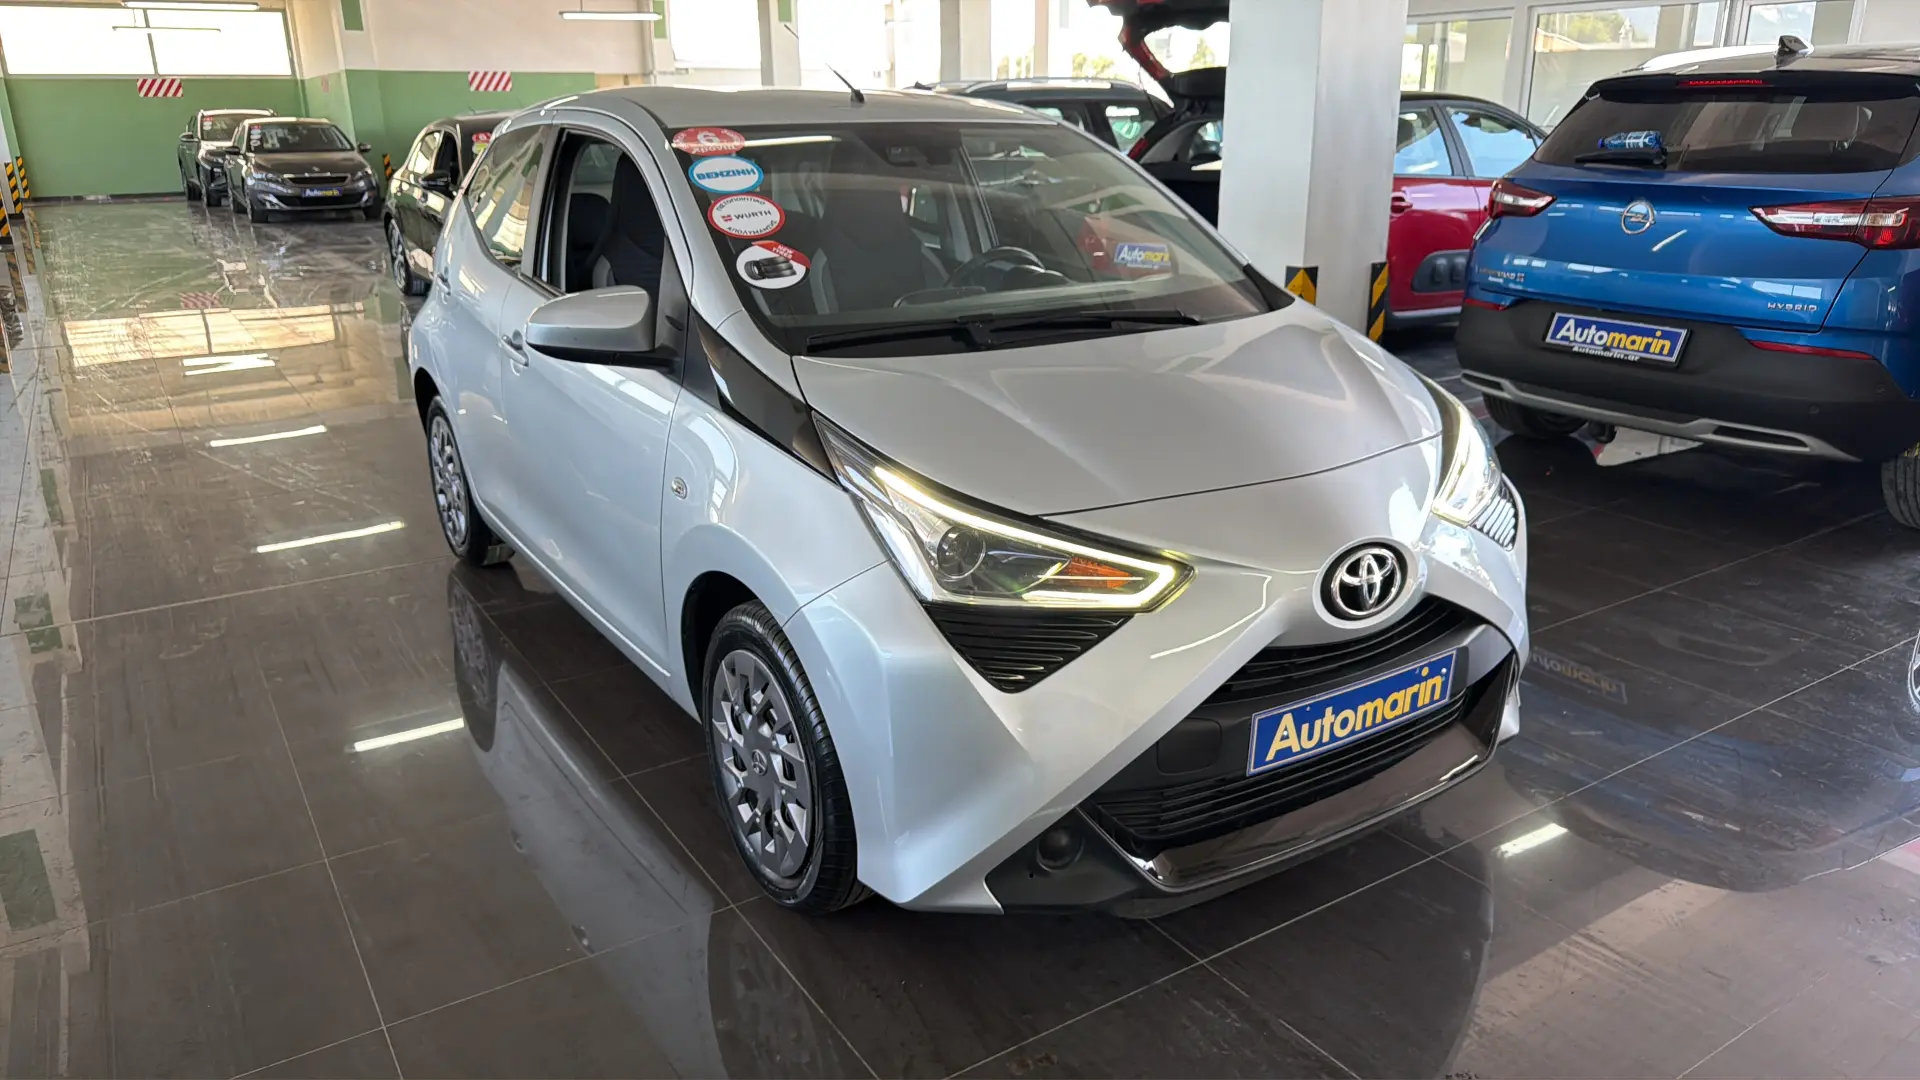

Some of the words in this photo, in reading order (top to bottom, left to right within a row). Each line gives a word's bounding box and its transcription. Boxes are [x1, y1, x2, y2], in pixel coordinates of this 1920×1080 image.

[1767, 302, 1817, 312] HYBRID
[1556, 318, 1671, 355] Automarin
[1265, 667, 1443, 762] Automarin
